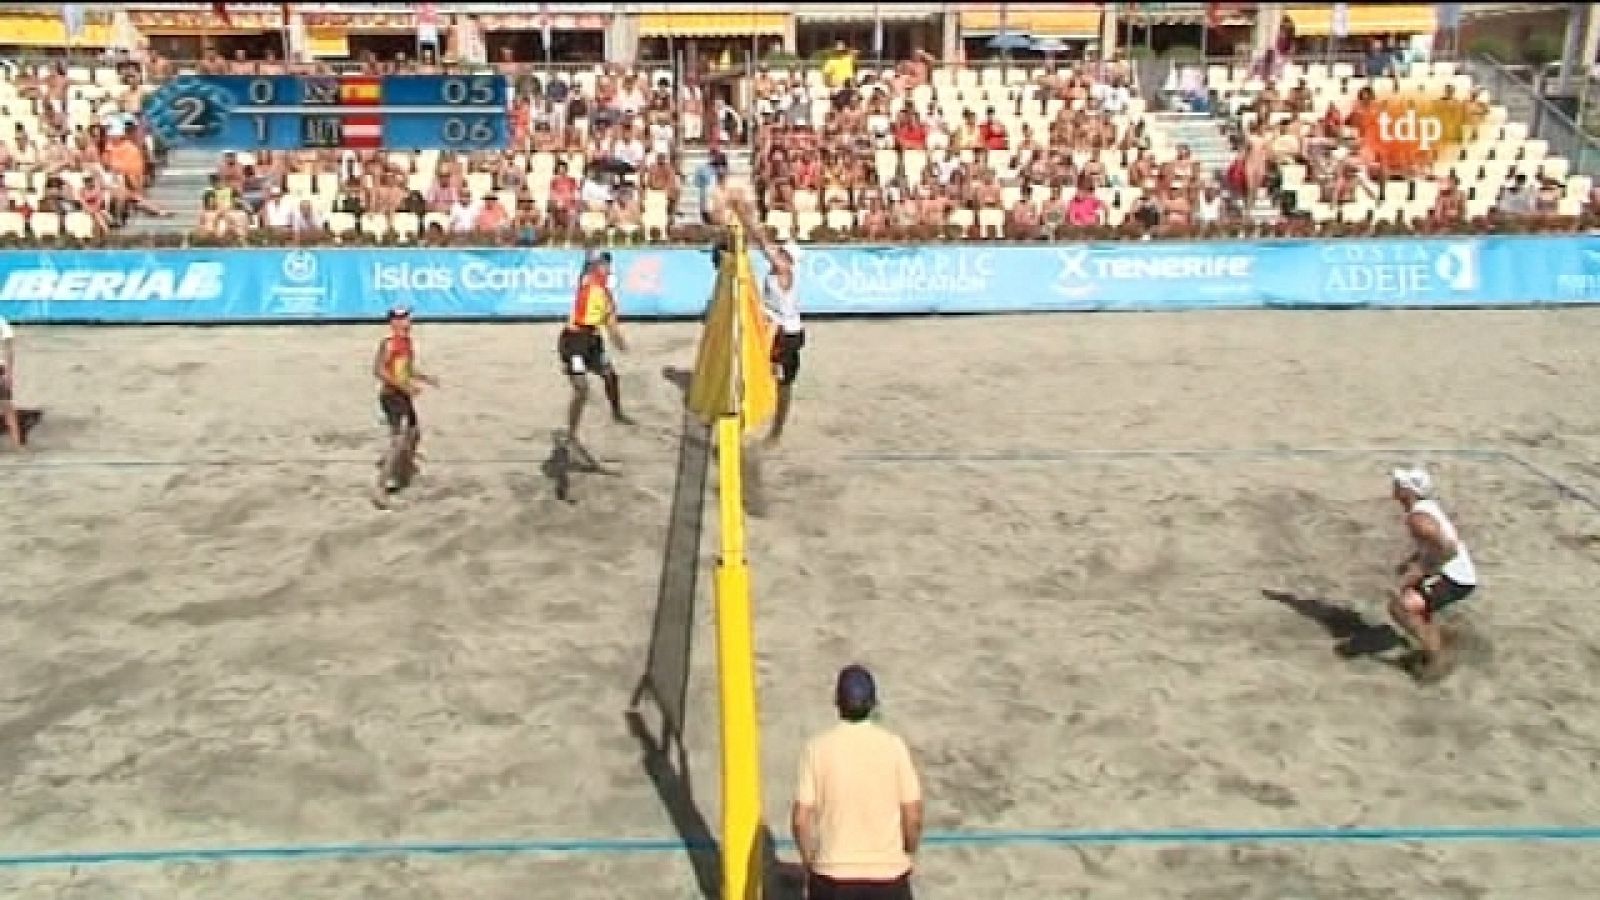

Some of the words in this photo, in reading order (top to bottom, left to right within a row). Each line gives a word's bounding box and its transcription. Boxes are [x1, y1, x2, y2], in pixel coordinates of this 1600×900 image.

[1, 267, 178, 301] IBERIA
[374, 260, 453, 292] Islas
[1323, 263, 1434, 297] ADEJE
